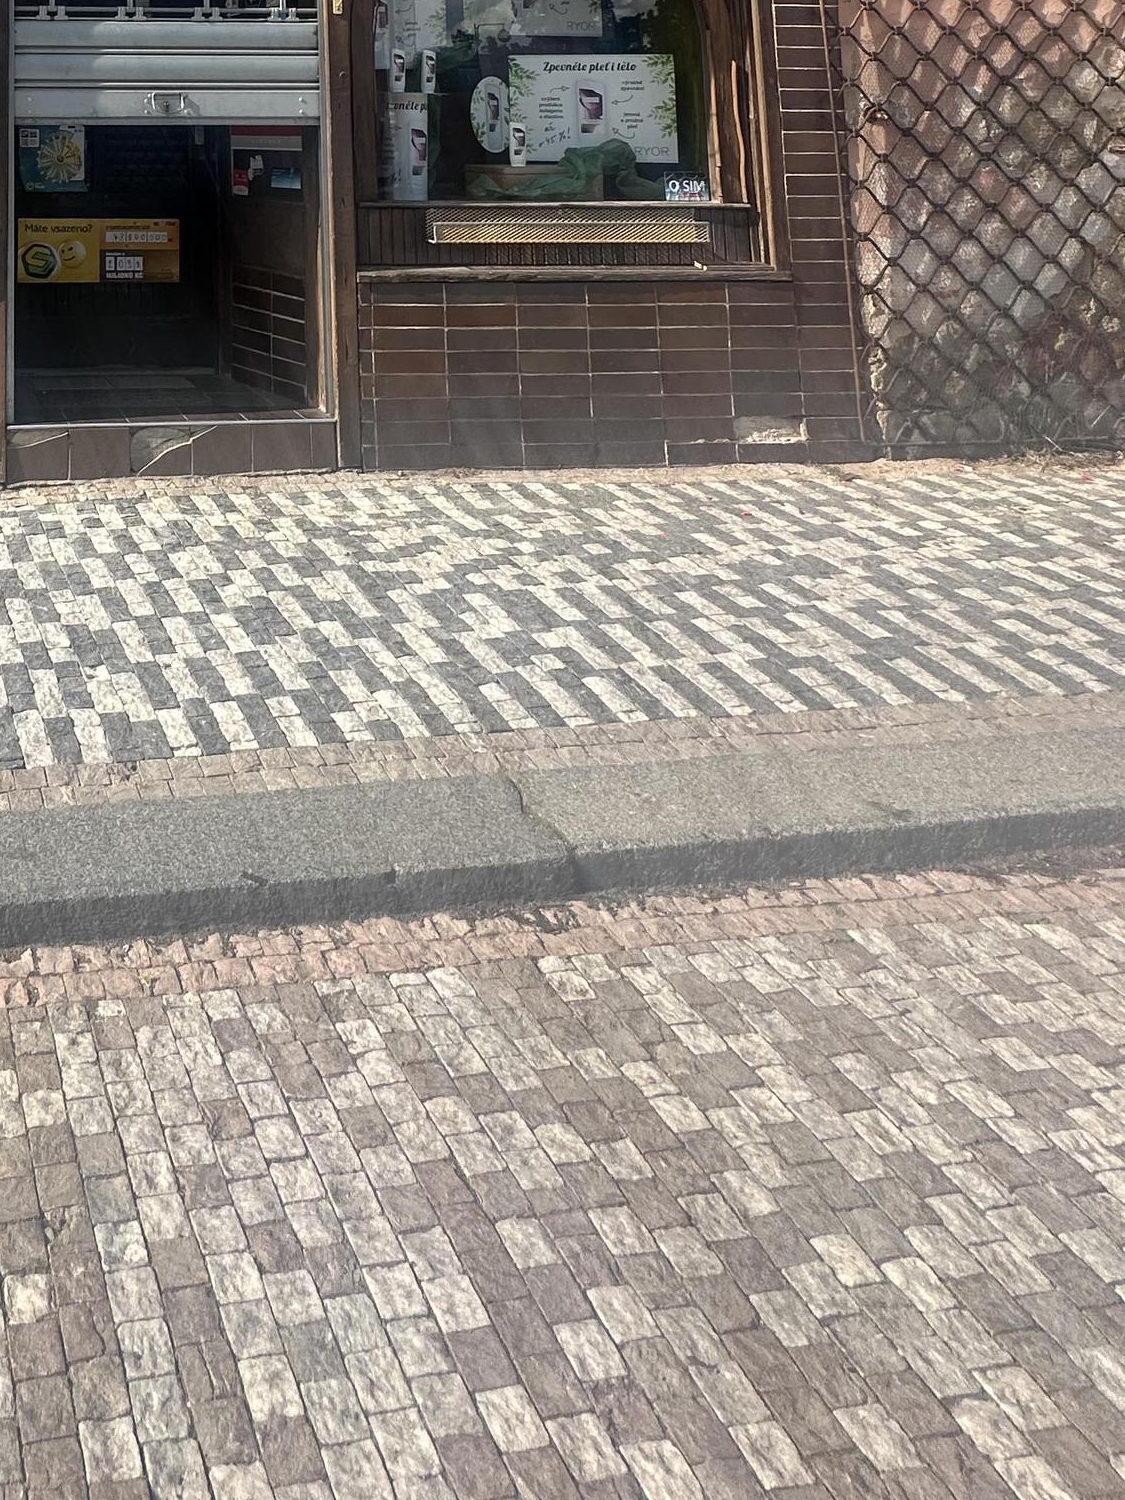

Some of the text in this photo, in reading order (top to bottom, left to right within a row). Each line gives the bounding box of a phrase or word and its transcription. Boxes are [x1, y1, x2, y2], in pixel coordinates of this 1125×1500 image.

[543, 61, 588, 74] Zpevněte
[588, 61, 610, 74] pleť
[616, 61, 638, 72] tělo
[635, 145, 671, 157] RYOR
[24, 223, 50, 234] Máte
[50, 223, 93, 235] vsazeno?
